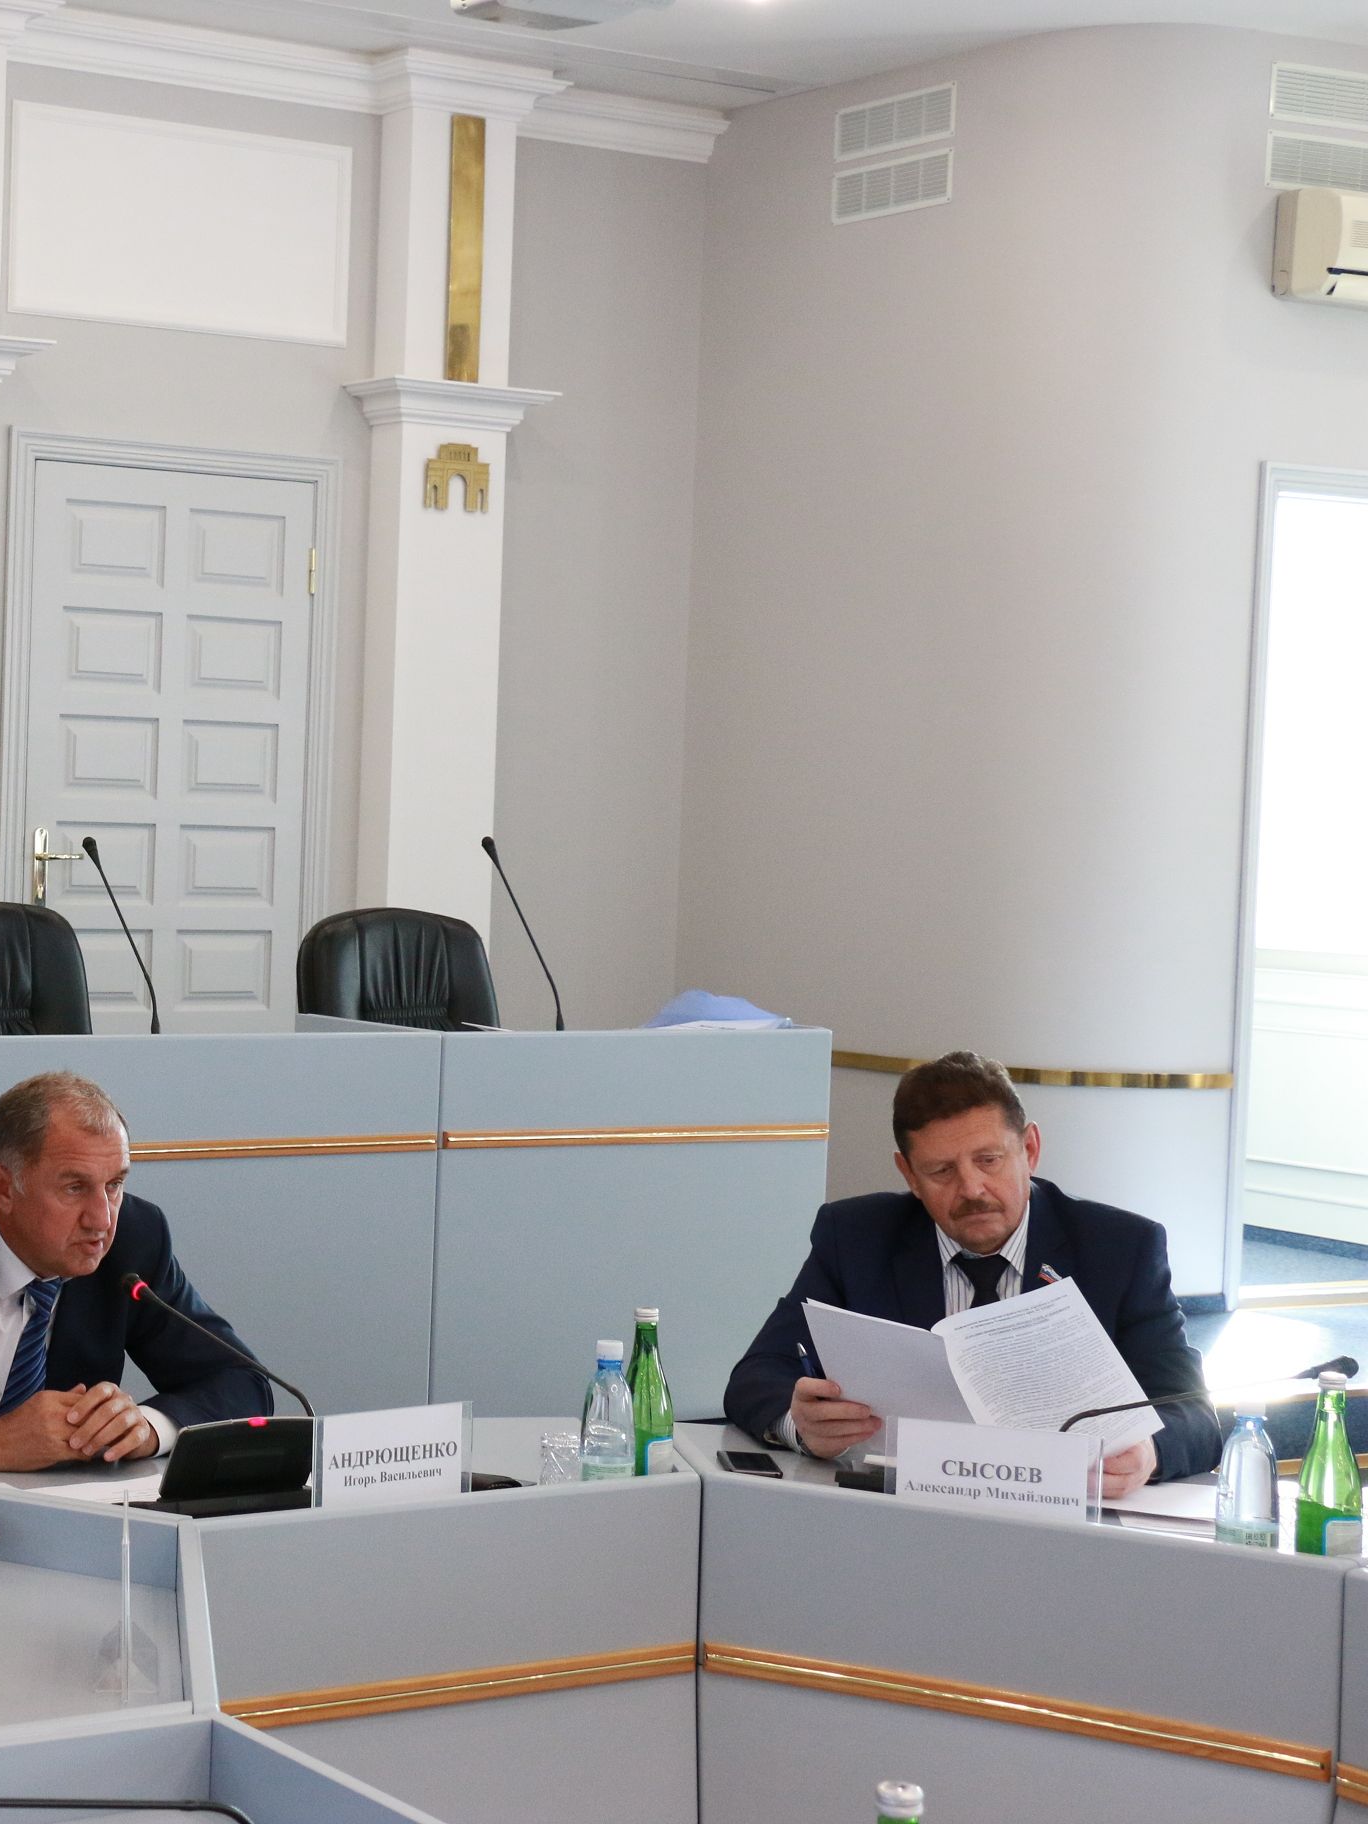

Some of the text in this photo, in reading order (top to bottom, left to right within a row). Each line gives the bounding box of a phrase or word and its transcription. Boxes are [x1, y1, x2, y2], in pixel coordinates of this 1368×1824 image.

[328, 1440, 458, 1470] АНДРЮЩЕНКО
[343, 1467, 442, 1488] Игорь Васильевич
[941, 1459, 1043, 1484] СЫСОЕВ
[904, 1479, 1080, 1507] Александр Михайлович
